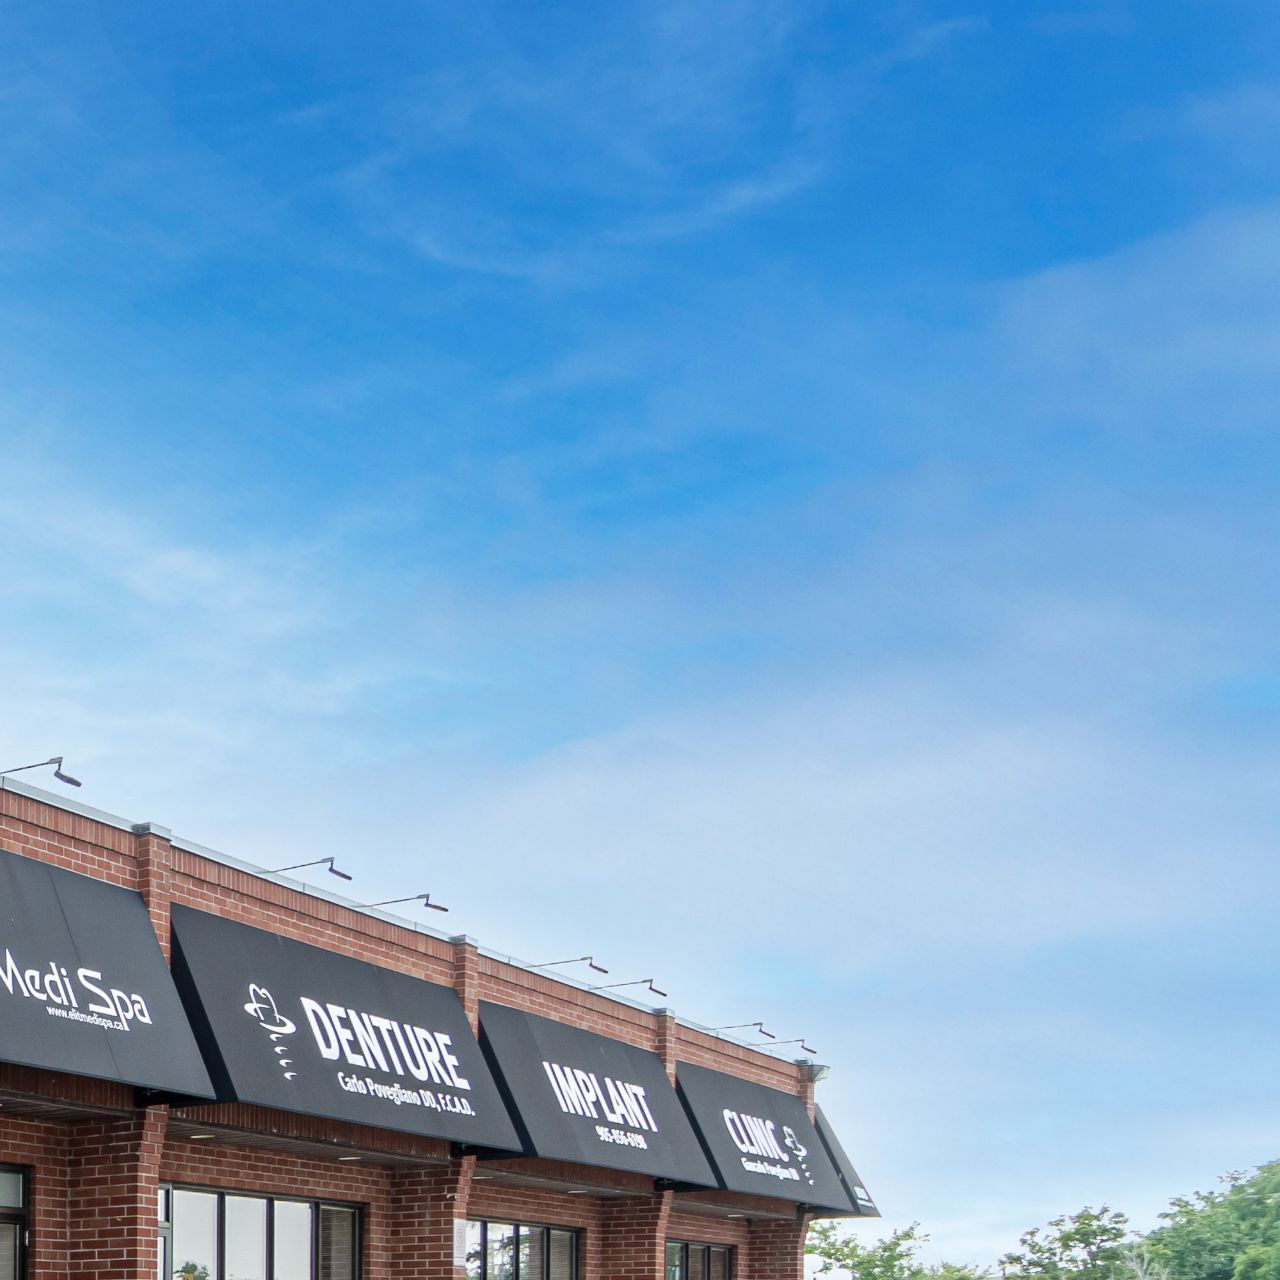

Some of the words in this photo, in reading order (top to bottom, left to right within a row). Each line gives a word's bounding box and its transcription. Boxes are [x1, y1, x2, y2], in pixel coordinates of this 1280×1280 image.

[77, 967, 153, 1032] Spa
[300, 996, 472, 1091] DENTURE
[337, 1071, 367, 1095] Carlo
[542, 1061, 659, 1133] IMPLANT
[722, 1108, 790, 1163] CLINIC
